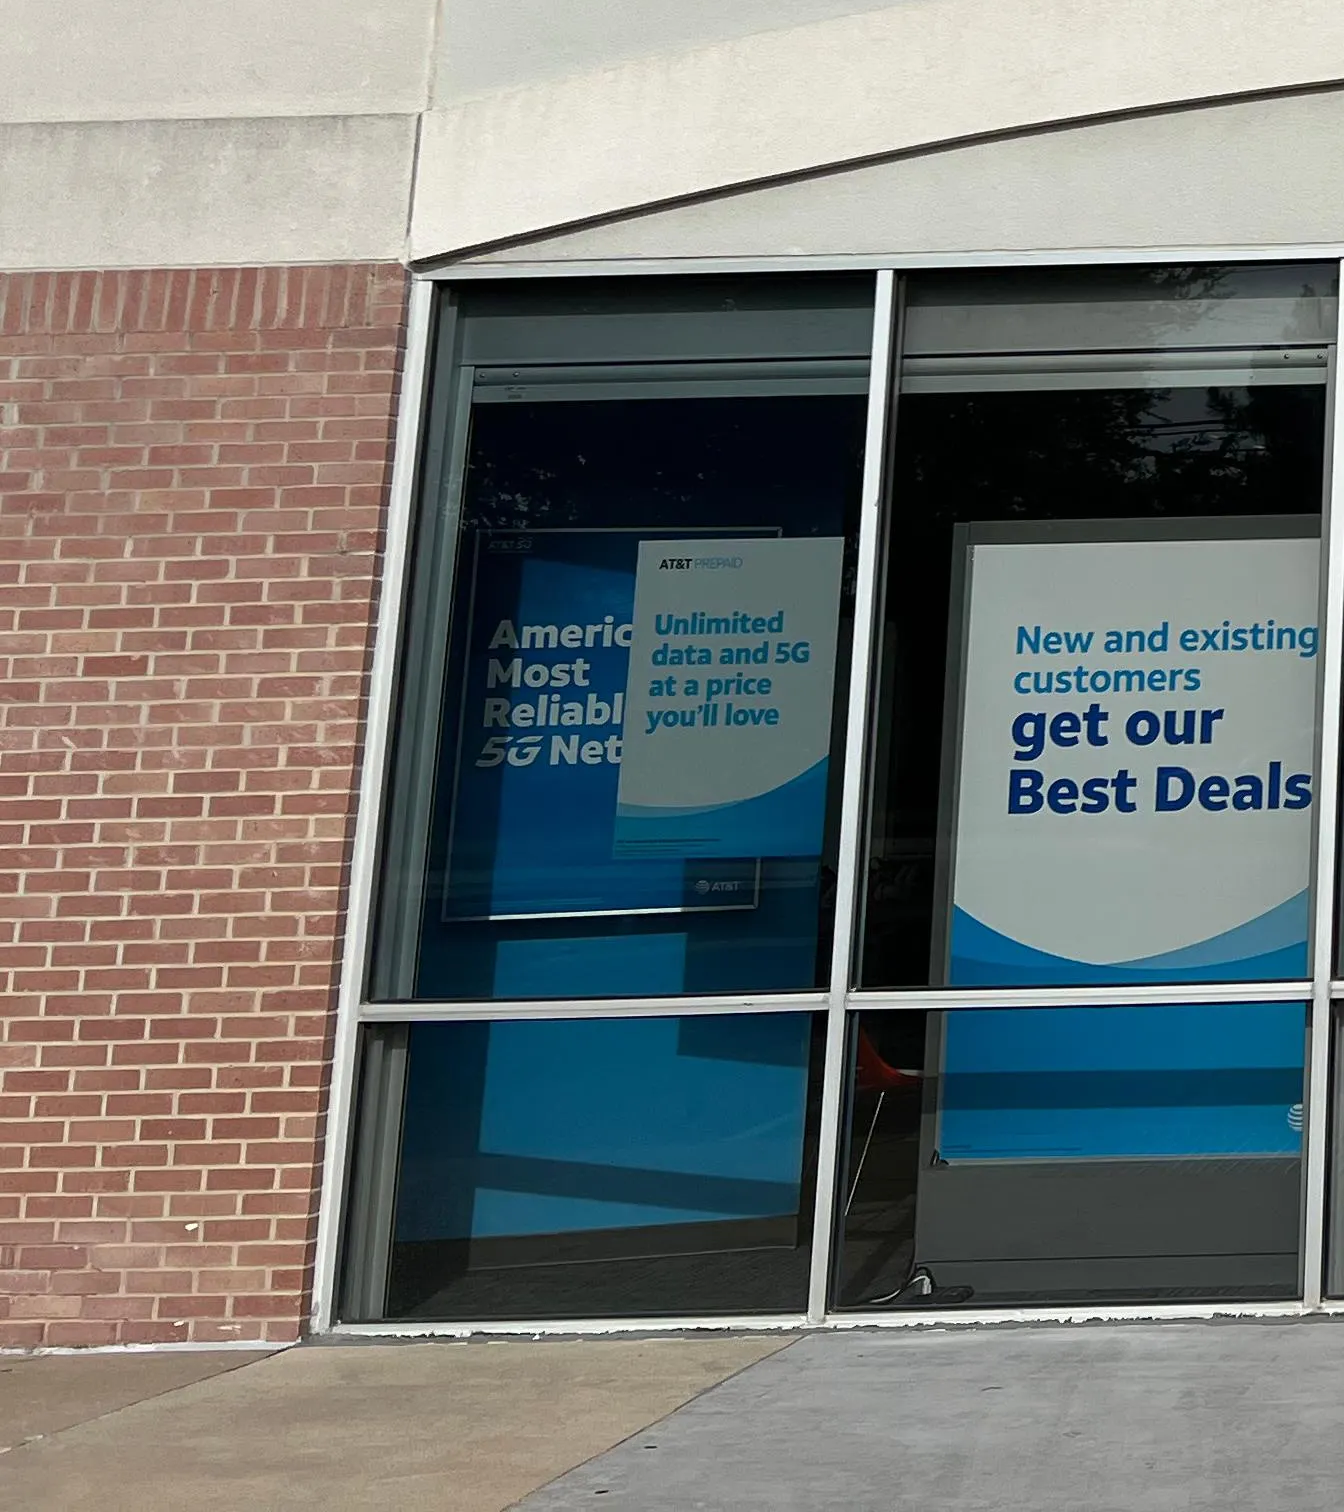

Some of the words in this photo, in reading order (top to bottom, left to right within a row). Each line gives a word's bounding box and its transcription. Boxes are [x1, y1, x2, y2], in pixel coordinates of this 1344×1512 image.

[659, 558, 693, 570] AT&T
[694, 557, 743, 569] PREPAID
[488, 616, 633, 649] Americ
[654, 611, 784, 636] Unlimited
[1015, 626, 1095, 655] New
[1104, 622, 1169, 653] and
[1180, 620, 1319, 658] existing
[651, 644, 712, 667] data
[719, 641, 768, 665] and
[774, 642, 810, 664] 5G
[487, 657, 590, 688] Most
[648, 676, 677, 697] at
[684, 679, 699, 696] a
[705, 673, 772, 702] price
[1014, 666, 1201, 694] customers
[483, 692, 624, 728] Reliabl
[645, 703, 718, 734] you'll
[725, 703, 779, 726] love
[1011, 703, 1109, 761] get
[1125, 709, 1225, 746] our
[475, 735, 544, 768] 5G
[550, 734, 623, 766] Net
[1008, 769, 1137, 814] Best
[1155, 761, 1313, 813] Deals
[711, 881, 740, 891] AT&T
